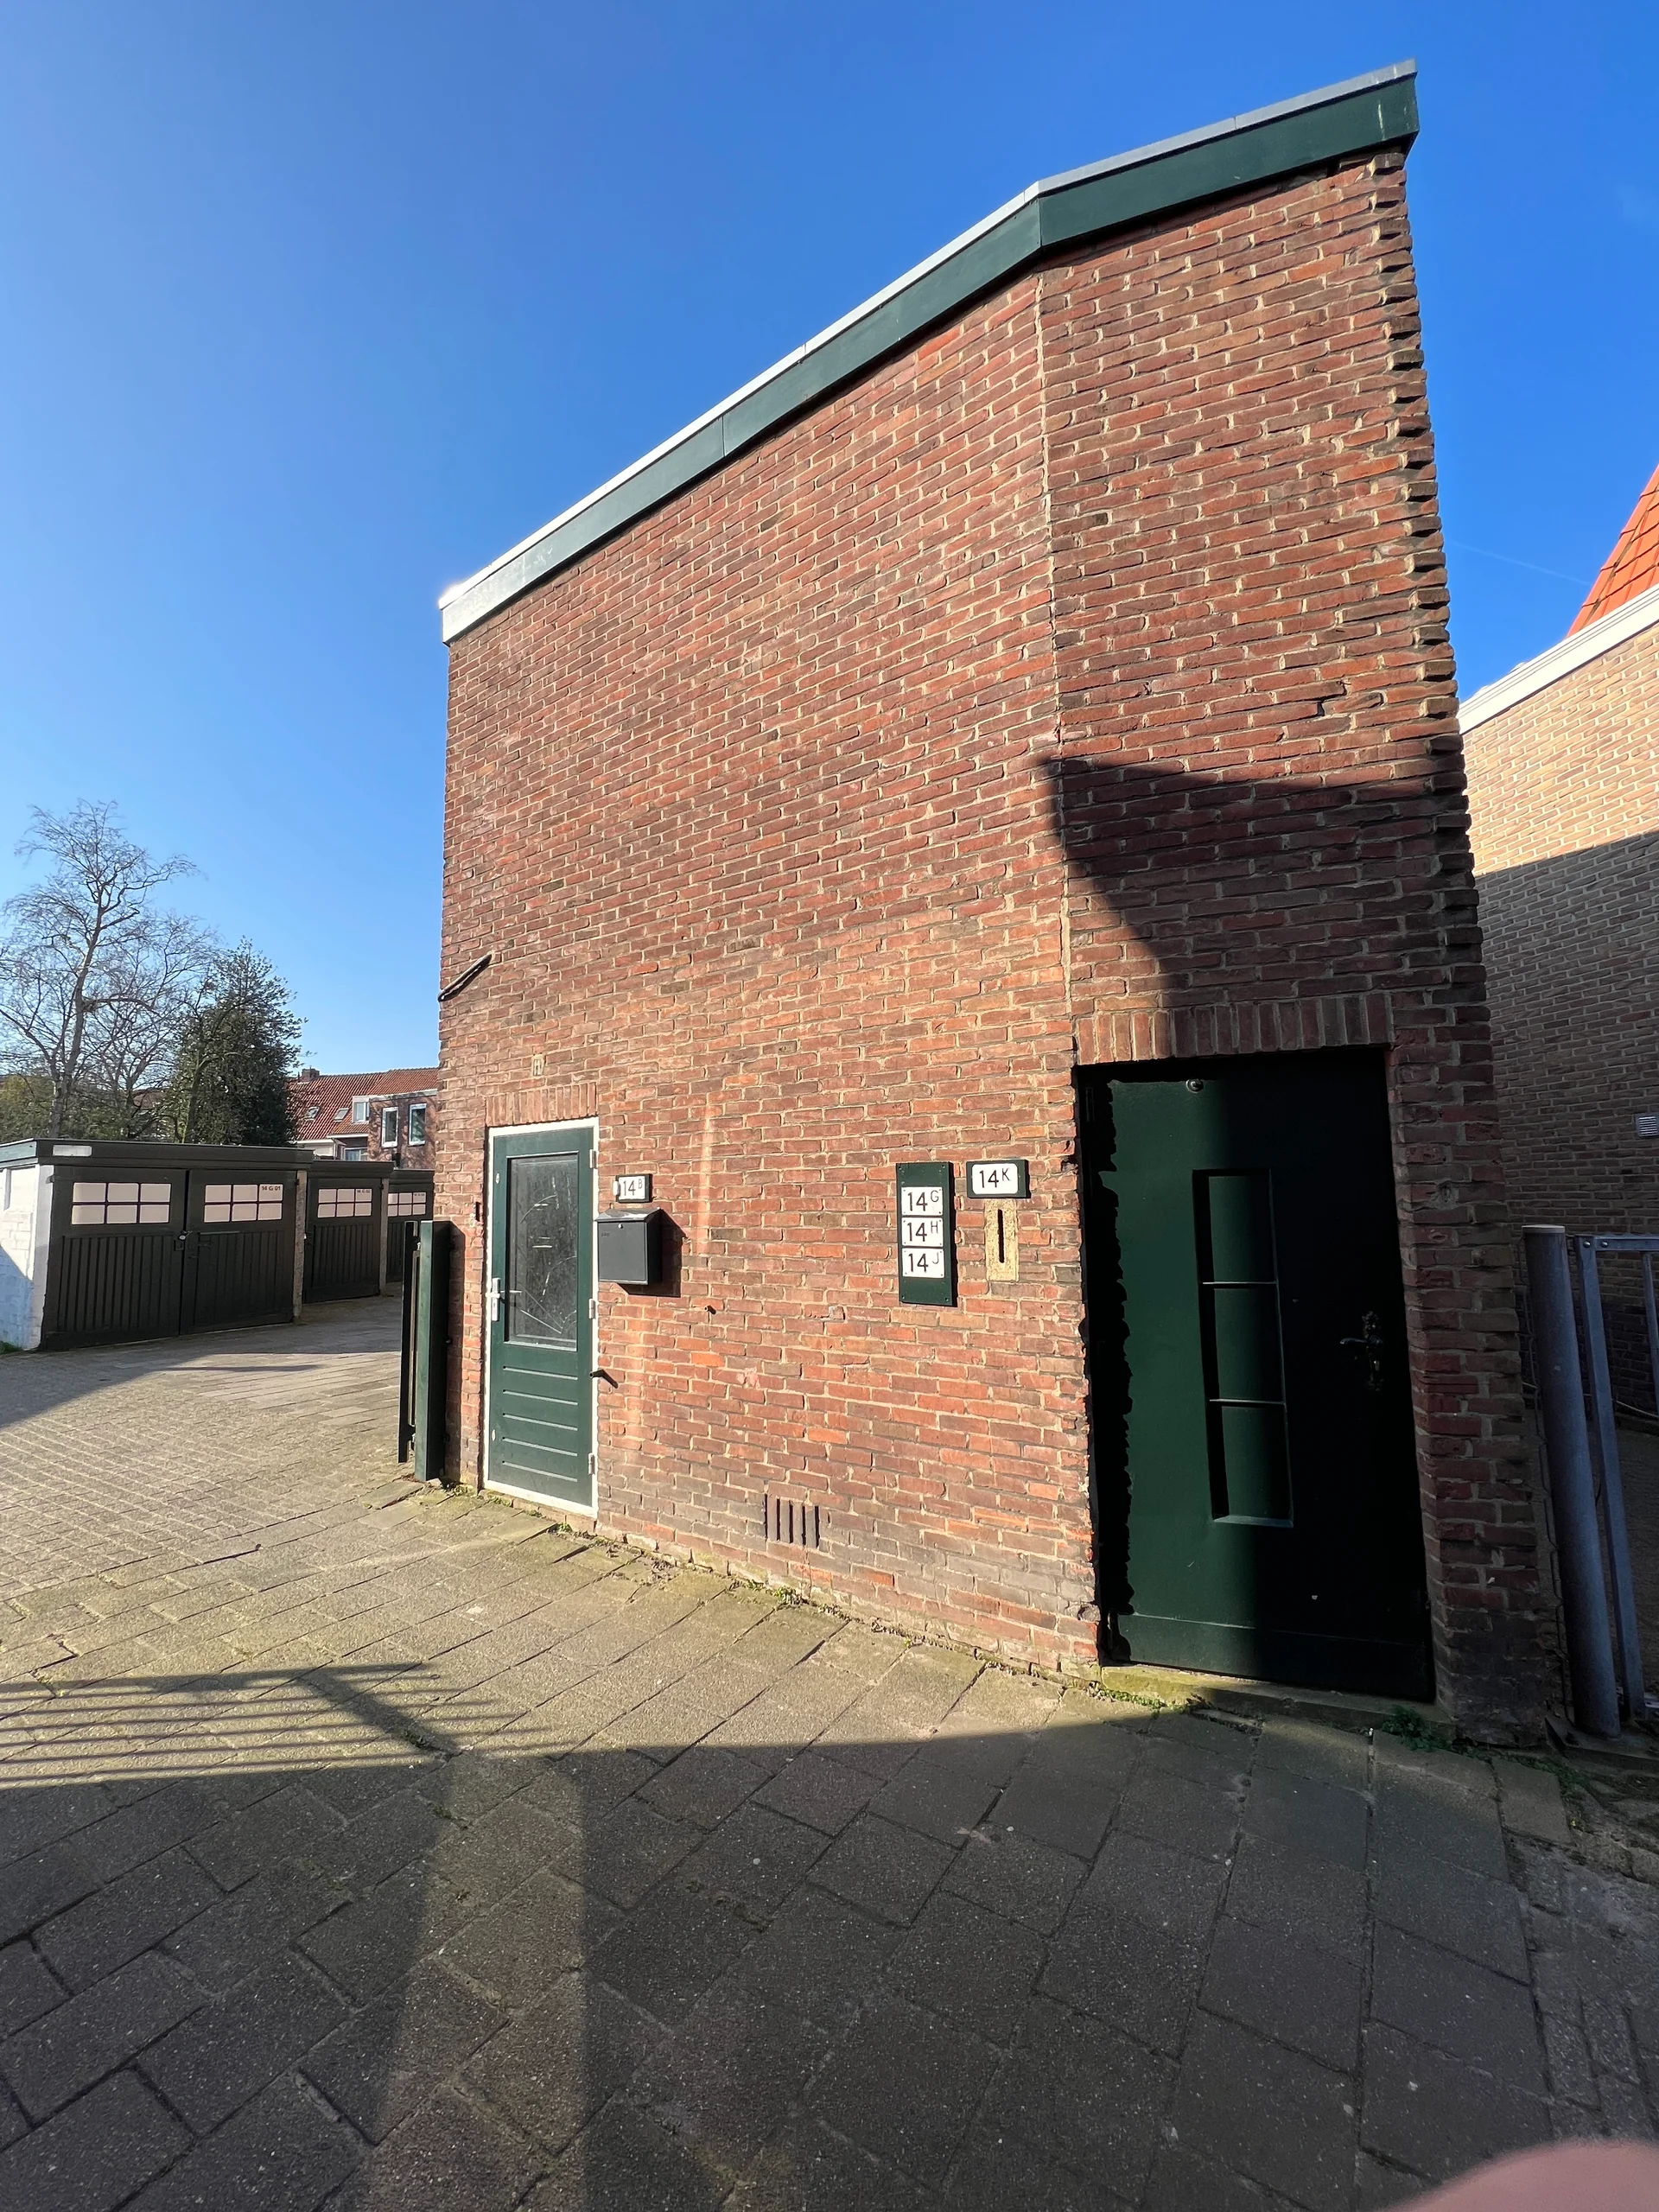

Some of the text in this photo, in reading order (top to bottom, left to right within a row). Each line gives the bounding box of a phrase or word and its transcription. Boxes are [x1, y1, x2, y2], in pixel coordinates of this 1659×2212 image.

[979, 1167, 1011, 1189] 14K
[907, 1190, 940, 1212] 14G
[907, 1220, 939, 1243] 14H
[908, 1252, 940, 1273] 14J
